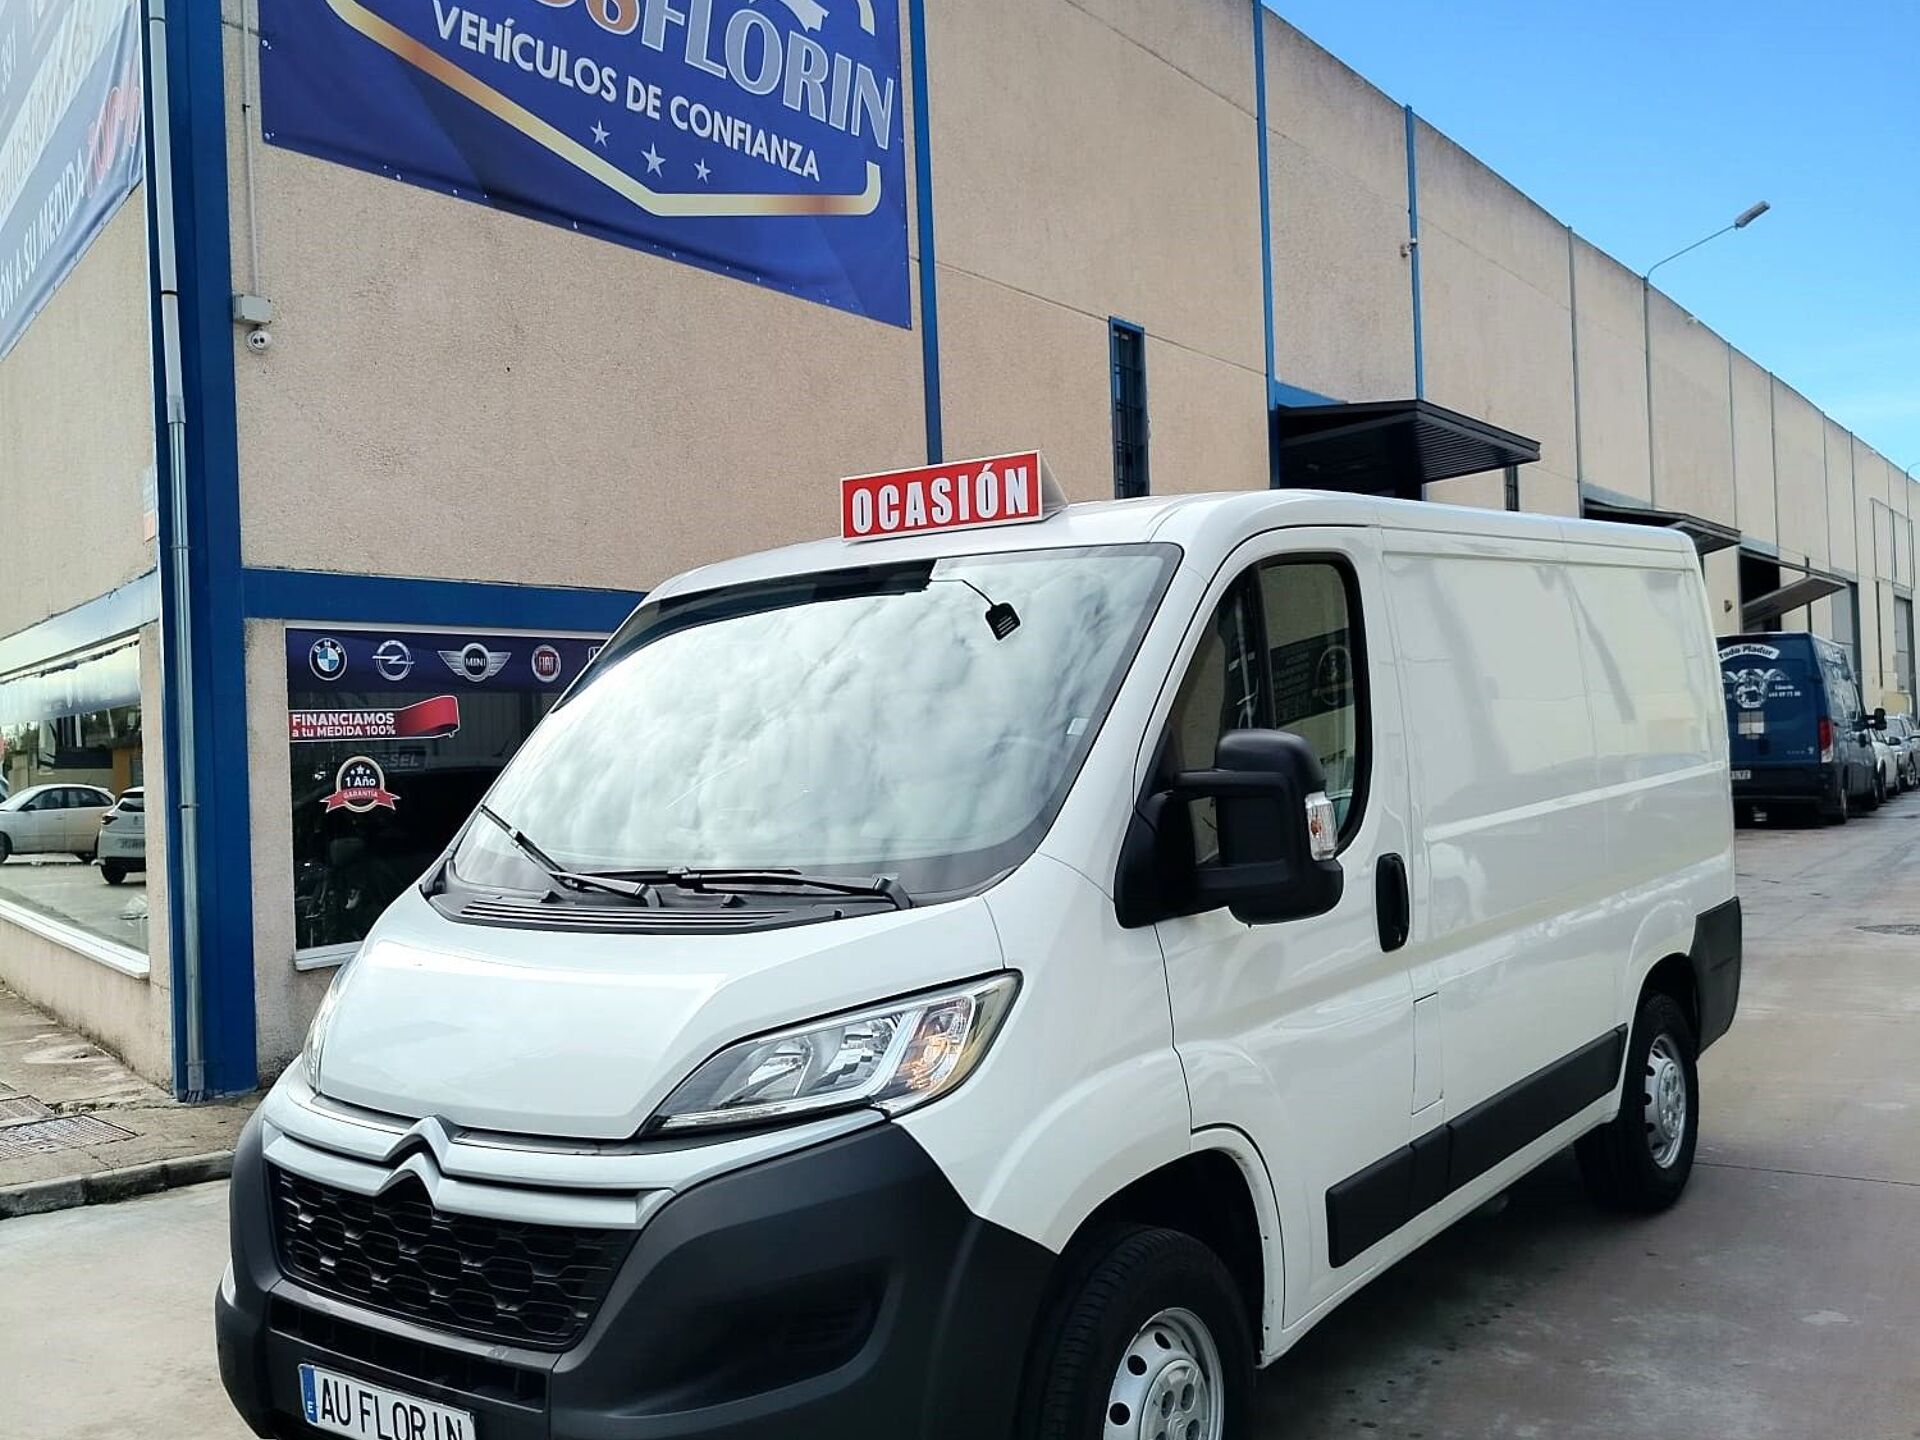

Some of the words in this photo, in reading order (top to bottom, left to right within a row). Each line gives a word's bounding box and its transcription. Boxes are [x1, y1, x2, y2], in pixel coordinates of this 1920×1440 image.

[535, 0, 894, 151] FLORIN
[433, 0, 617, 103] VEHÍCULOS
[626, 76, 662, 120] DE
[670, 96, 819, 181] CONFIANZA
[16, 248, 23, 298] A
[24, 220, 37, 282] SU
[39, 149, 85, 260] MEDIDA
[852, 463, 1029, 534] OCASIÓN
[465, 657, 486, 667] MINI
[538, 655, 554, 671] FIAT
[292, 713, 395, 726] FINANCIAMOS
[292, 729, 299, 737] a
[302, 727, 314, 737] tu
[317, 726, 363, 736] MEDIDA
[366, 725, 396, 736] 100%
[346, 778, 351, 787] 1
[353, 776, 376, 787] Año
[307, 1401, 314, 1413] E
[321, 1379, 351, 1426] AU
[359, 1390, 463, 1440] FLORIN
